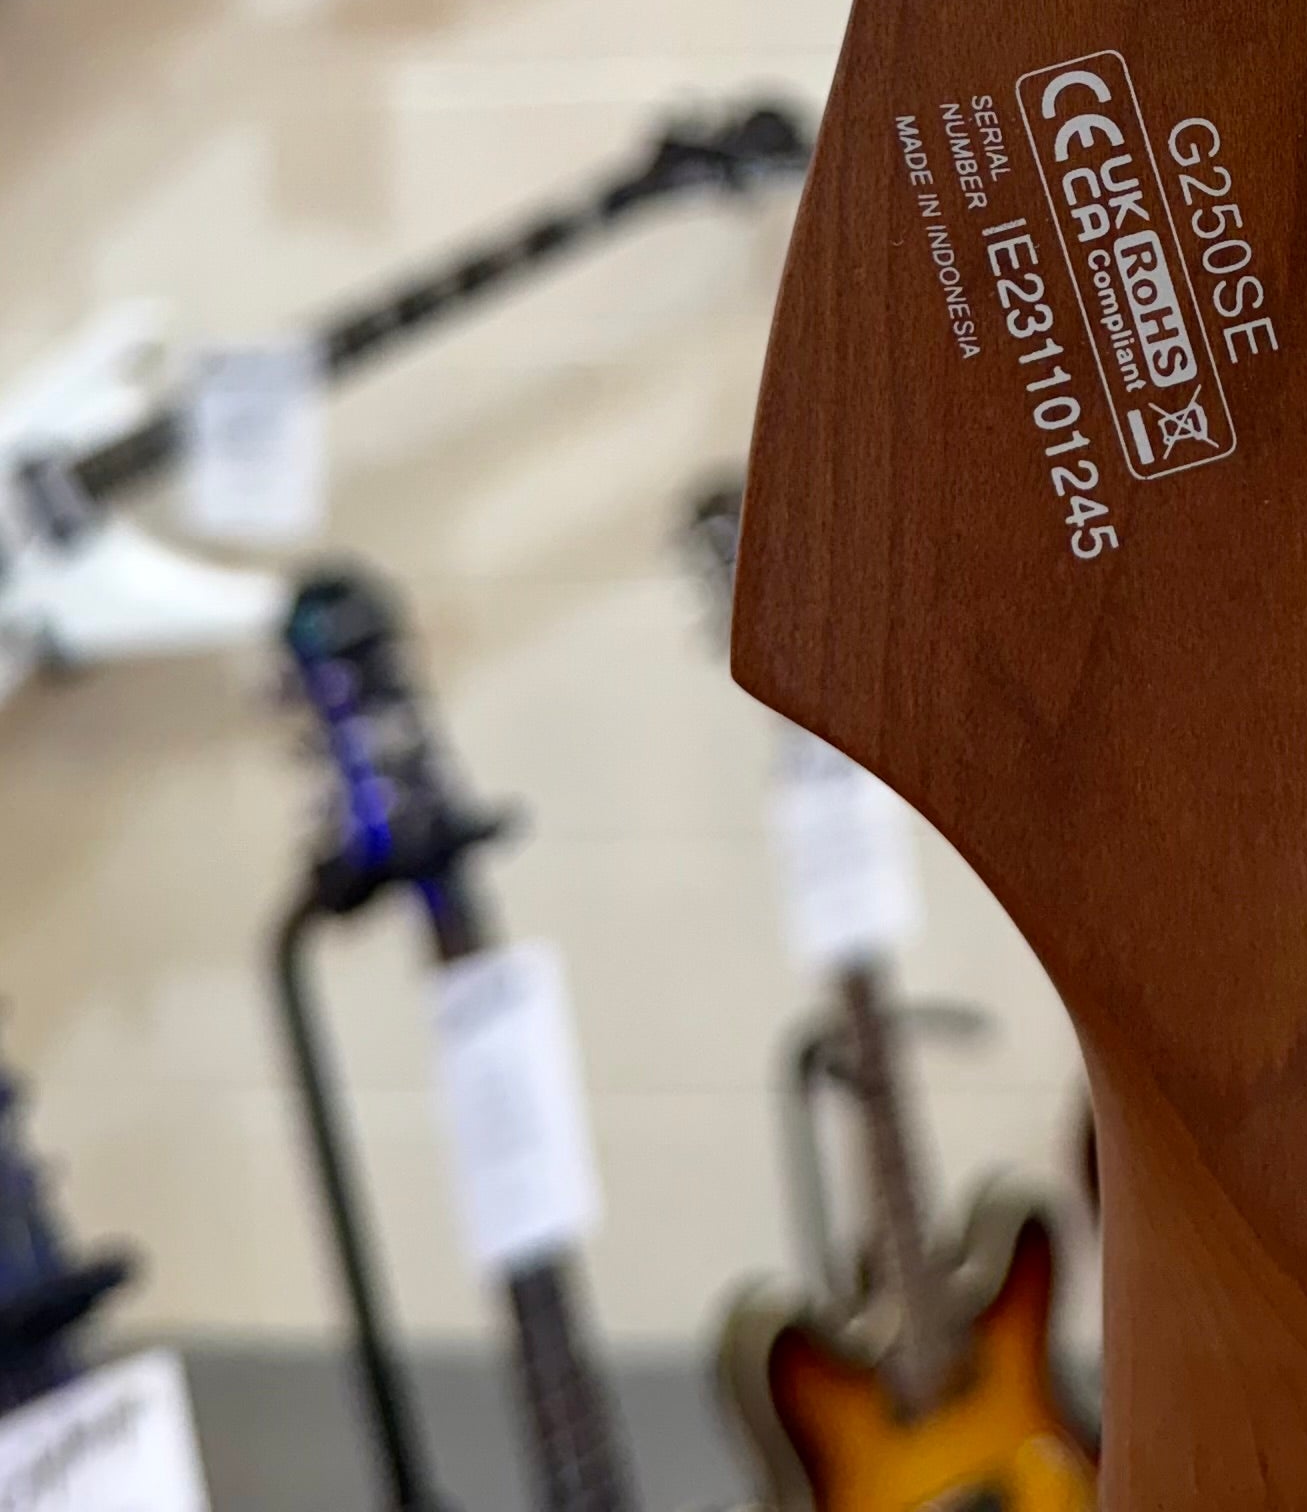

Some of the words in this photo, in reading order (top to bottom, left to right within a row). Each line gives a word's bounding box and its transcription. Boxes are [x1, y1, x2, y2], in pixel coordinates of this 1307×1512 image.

[895, 116, 933, 187] MADE
[971, 94, 1011, 183] SERIAL
[1041, 70, 1125, 161] CE
[917, 193, 942, 217] IN
[1062, 167, 1111, 242] CA
[1099, 155, 1150, 229] UK
[1167, 117, 1279, 363] G250SE
[926, 225, 981, 360] INDONESIA
[939, 102, 988, 210] NUMBER
[981, 217, 1119, 559] IE231101245
[1087, 249, 1147, 392] Compliant
[1117, 241, 1191, 377] RoHS
